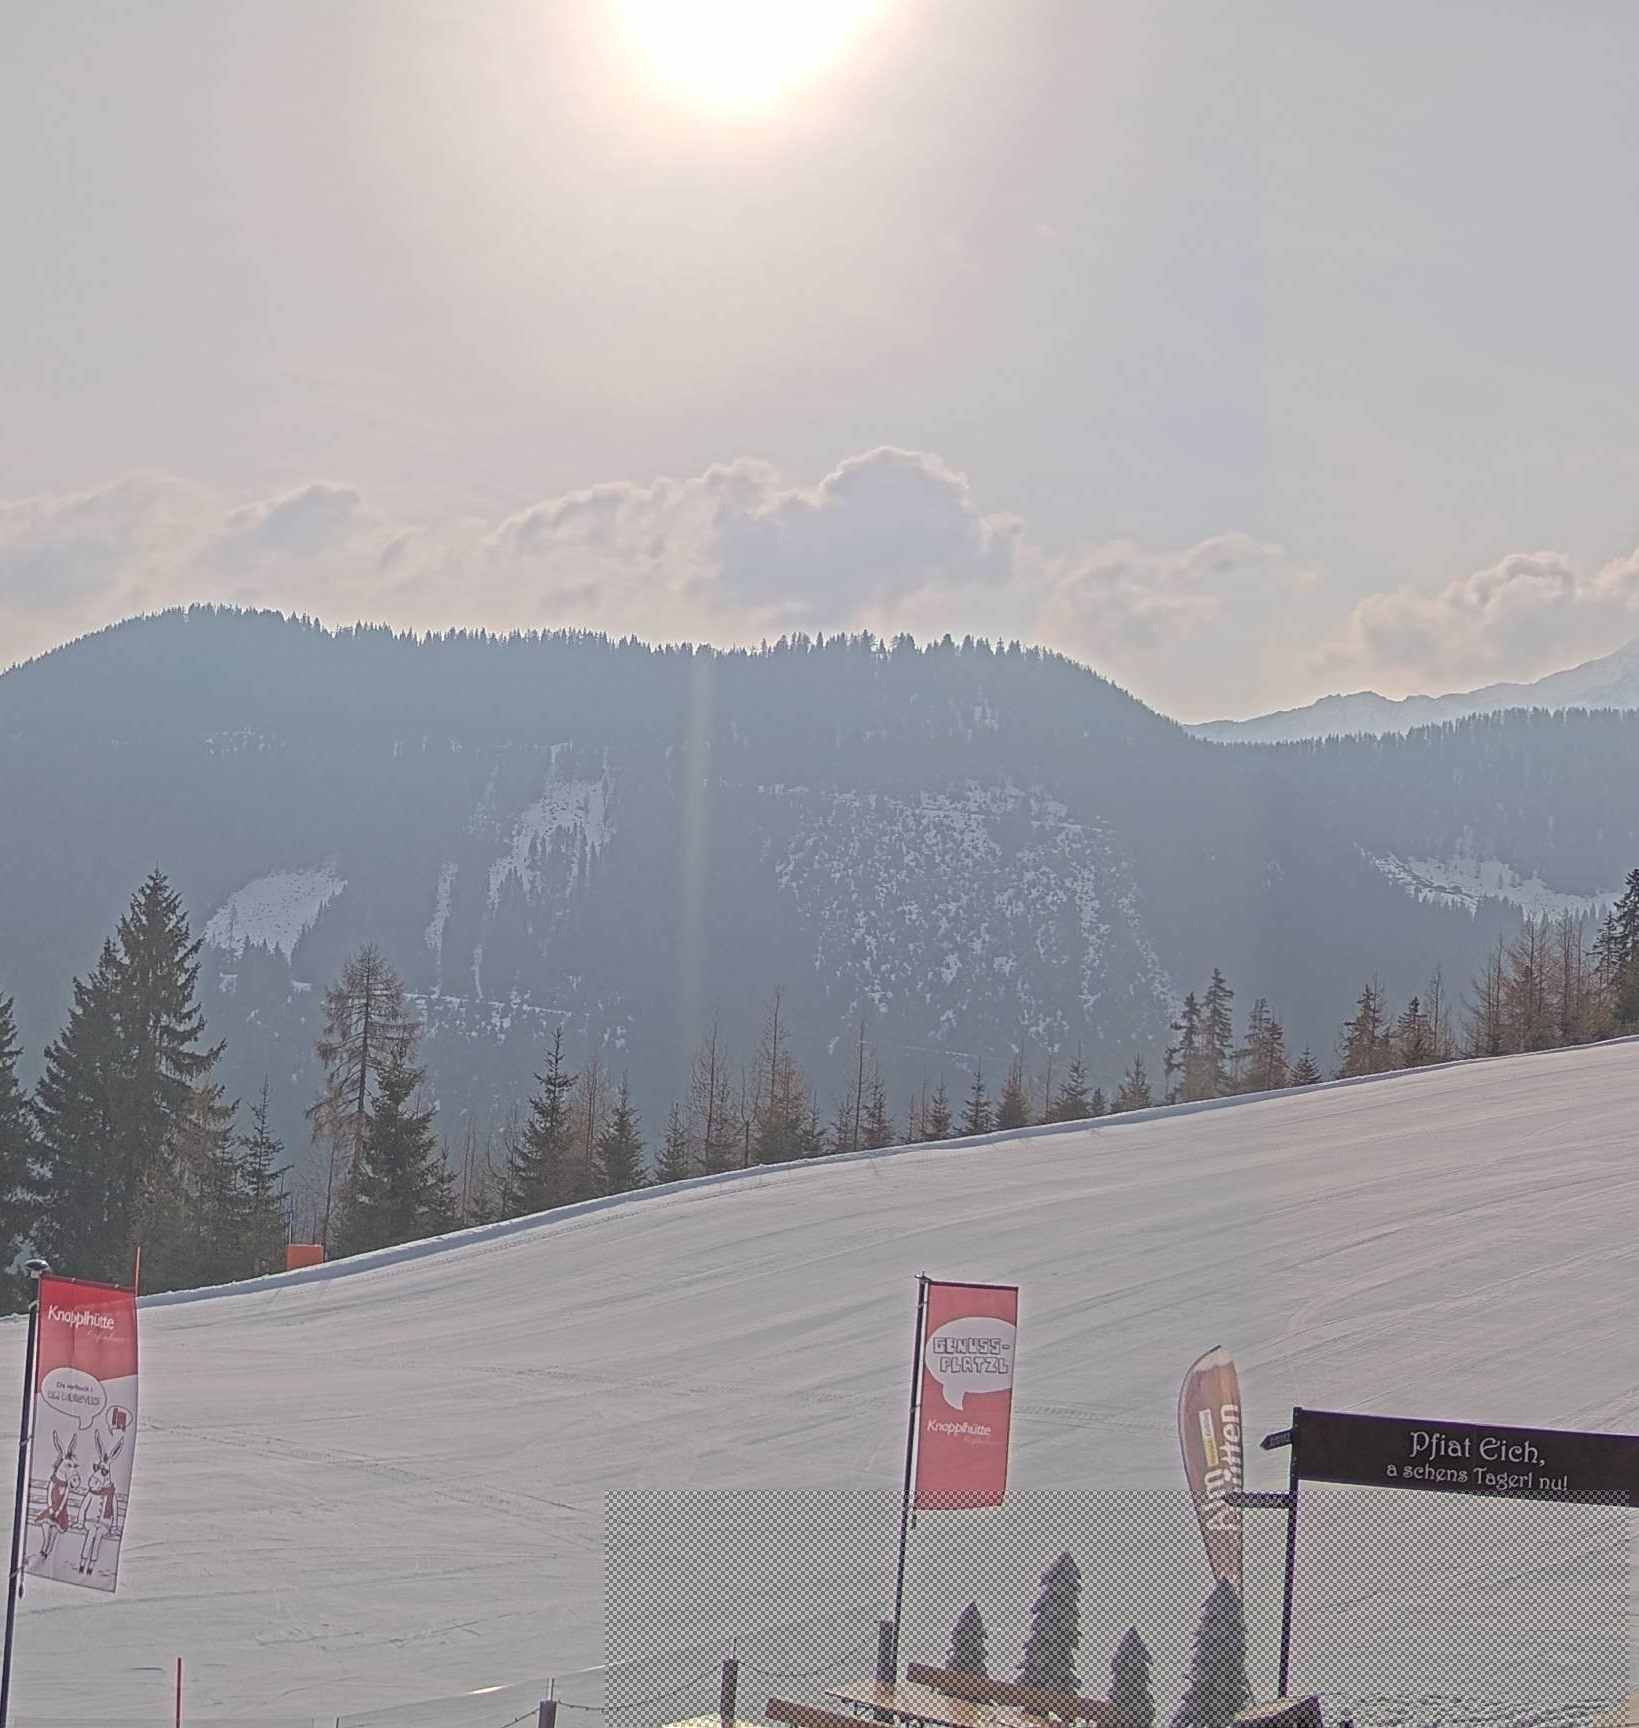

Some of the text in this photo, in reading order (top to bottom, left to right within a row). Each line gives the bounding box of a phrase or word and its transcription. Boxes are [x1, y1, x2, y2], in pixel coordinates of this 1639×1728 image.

[933, 1337, 1010, 1355] GENUSS-
[940, 1356, 1009, 1375] PLATZL
[1410, 1431, 1546, 1467] Pfiat Eich,
[1386, 1464, 1398, 1477] a
[1403, 1463, 1469, 1484] schens
[1474, 1467, 1533, 1491] Tagerl
